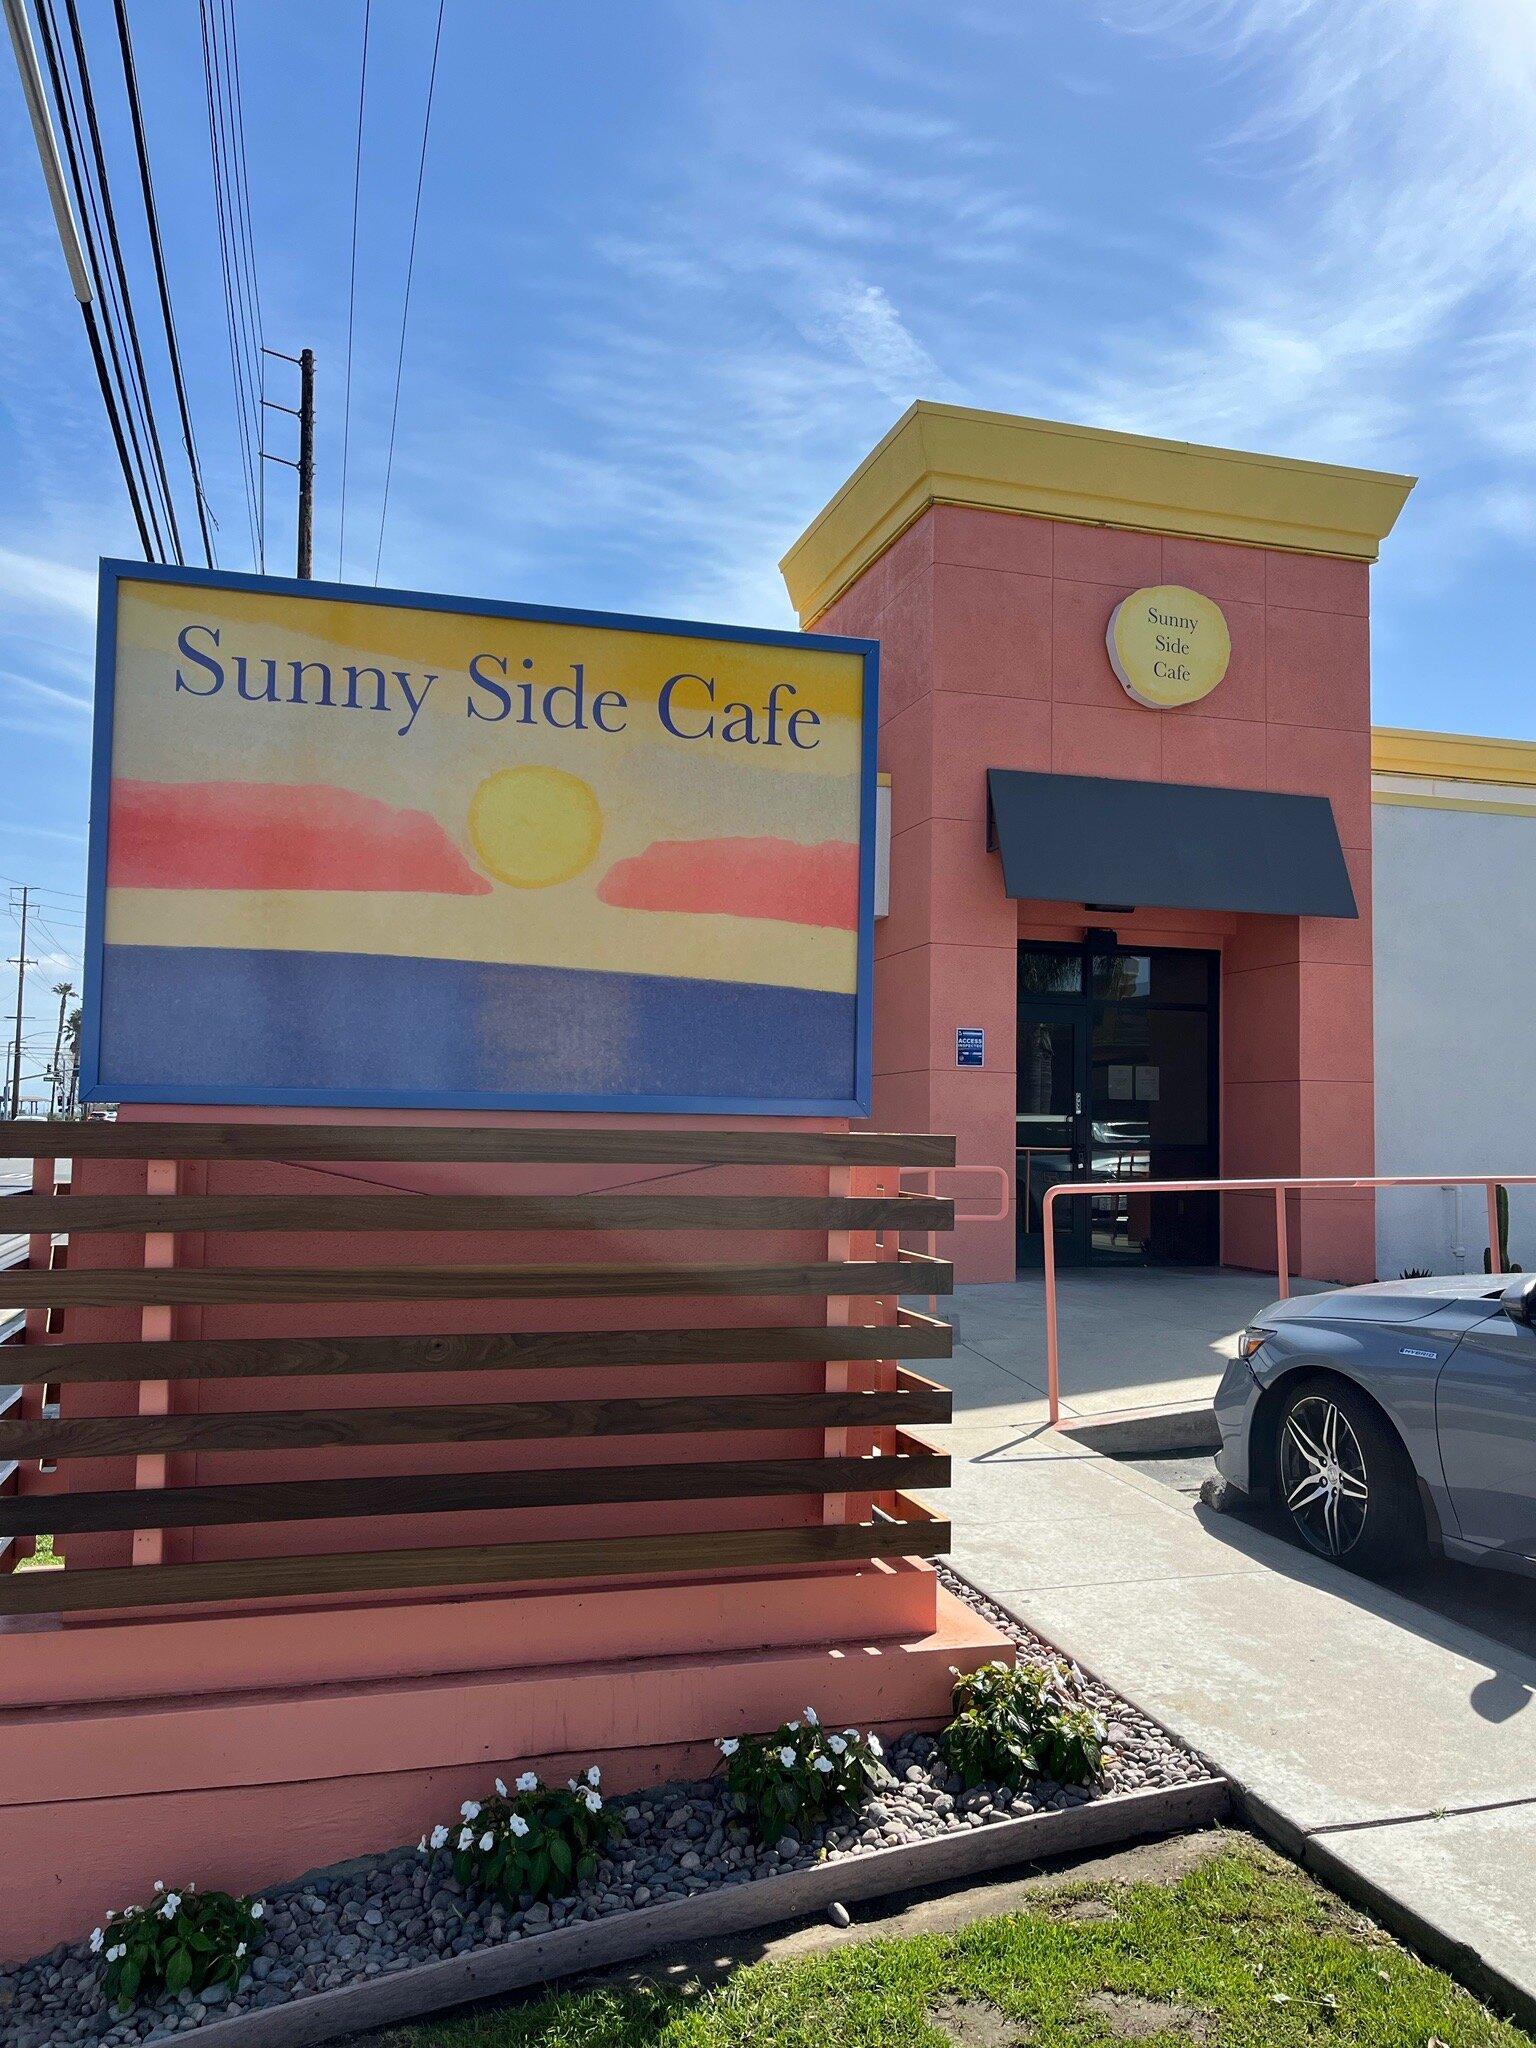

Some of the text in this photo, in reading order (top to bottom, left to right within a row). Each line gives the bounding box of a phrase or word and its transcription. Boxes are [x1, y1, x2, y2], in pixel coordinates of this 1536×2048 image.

[1148, 606, 1198, 634] Sunny
[1155, 634, 1190, 655] Side
[1153, 661, 1191, 682] Cafe
[175, 625, 821, 750] Sunny Side Cafe
[1404, 1349, 1435, 1357] HYBRID
